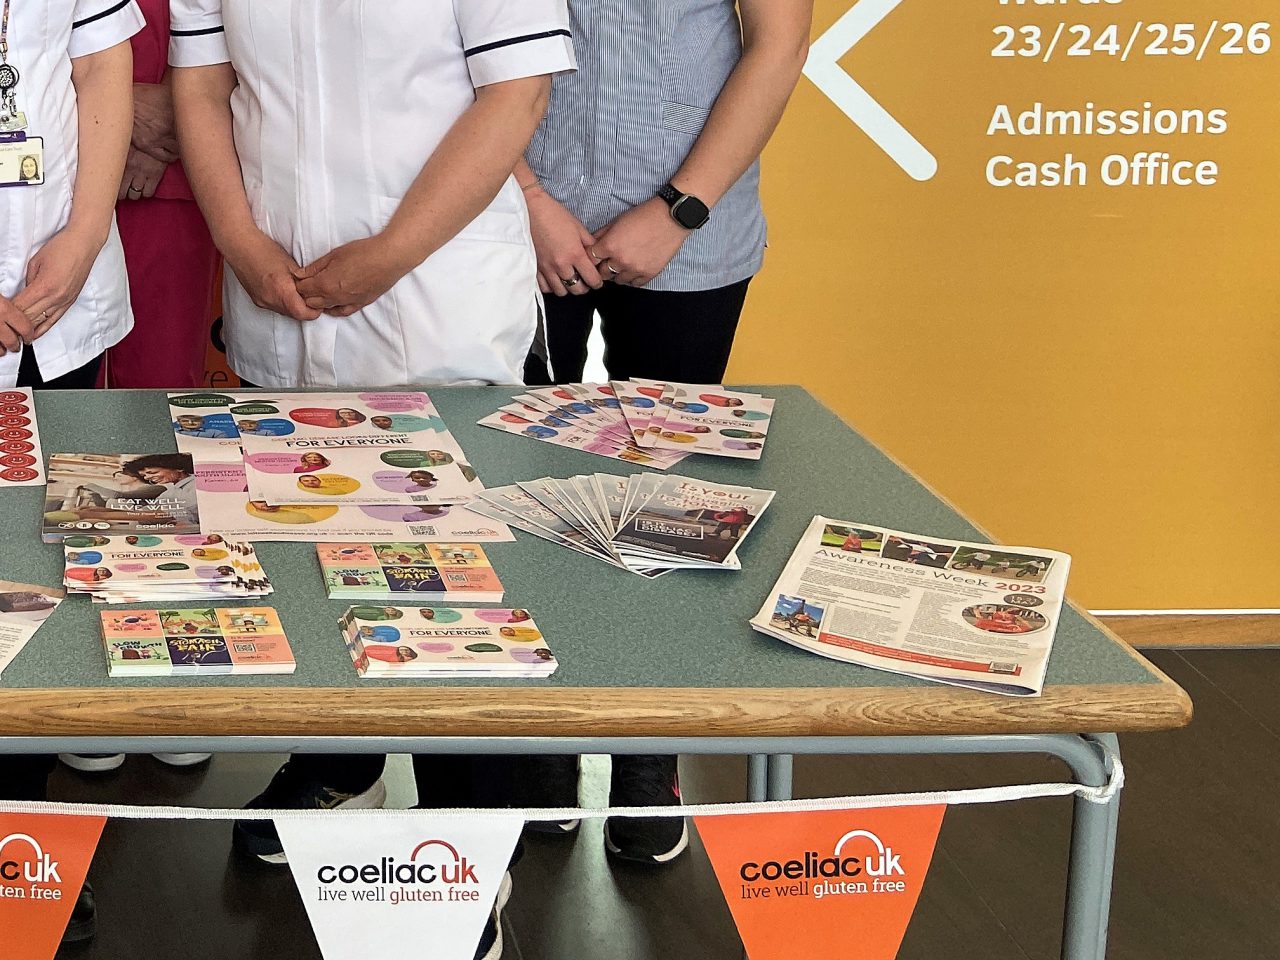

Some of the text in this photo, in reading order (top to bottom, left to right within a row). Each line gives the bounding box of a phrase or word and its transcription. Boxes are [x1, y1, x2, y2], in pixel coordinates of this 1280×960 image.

[990, 20, 1271, 62] 23/24/25/26
[986, 102, 1228, 136] Admissions
[985, 152, 1218, 187] Cash Office
[286, 437, 412, 448] FOR EVERYONE
[814, 548, 1047, 594] Awareness Week 2023
[434, 629, 493, 637] EVERYONE
[24, 853, 62, 884] uk
[318, 855, 479, 887] coeliac uk
[740, 848, 905, 882] coeliac uk
[29, 883, 62, 901] free
[318, 884, 479, 907] live well gluten free
[741, 878, 906, 900] live well gluten free
